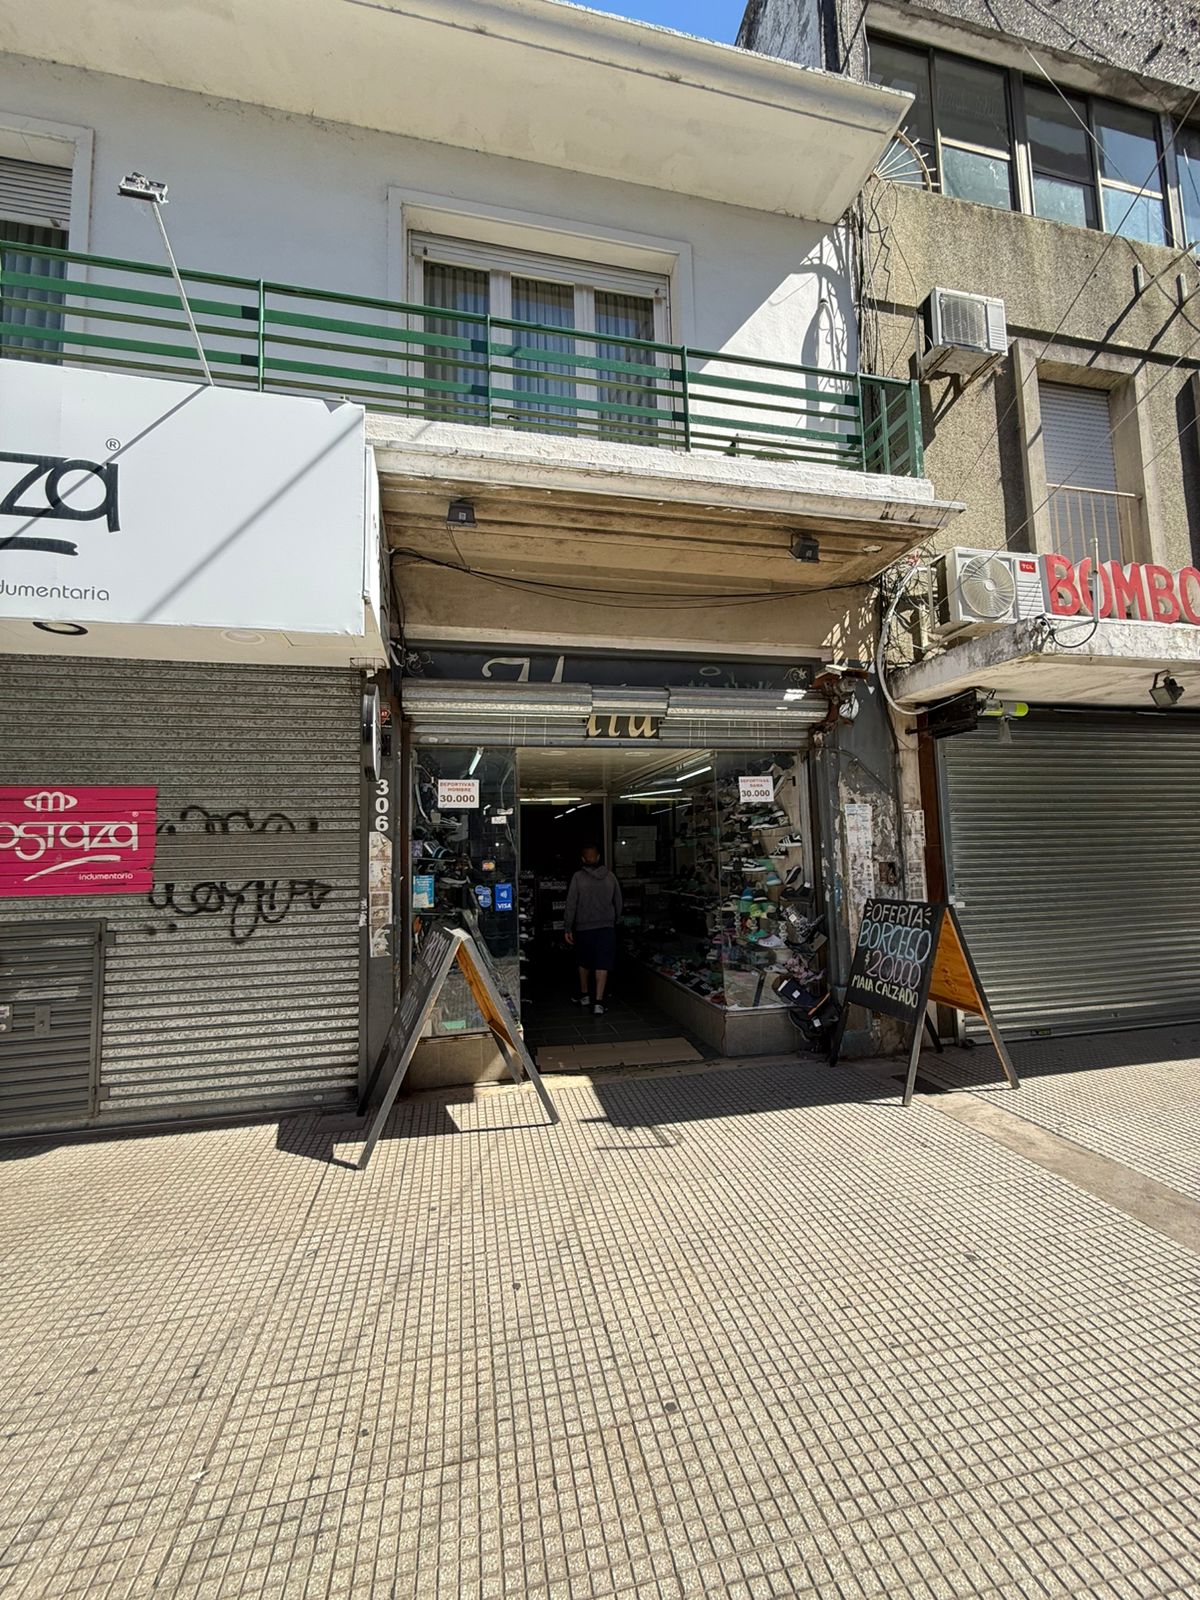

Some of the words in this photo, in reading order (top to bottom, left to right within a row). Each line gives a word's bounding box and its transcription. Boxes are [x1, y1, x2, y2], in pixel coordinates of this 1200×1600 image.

[375, 779, 390, 832] 306
[440, 794, 475, 803] 30.000
[741, 789, 771, 798] 30.000
[871, 903, 924, 928] OFERTA
[858, 919, 932, 964] BORCEGO
[851, 974, 874, 992] MAIA
[875, 980, 919, 1009] CALZADO
